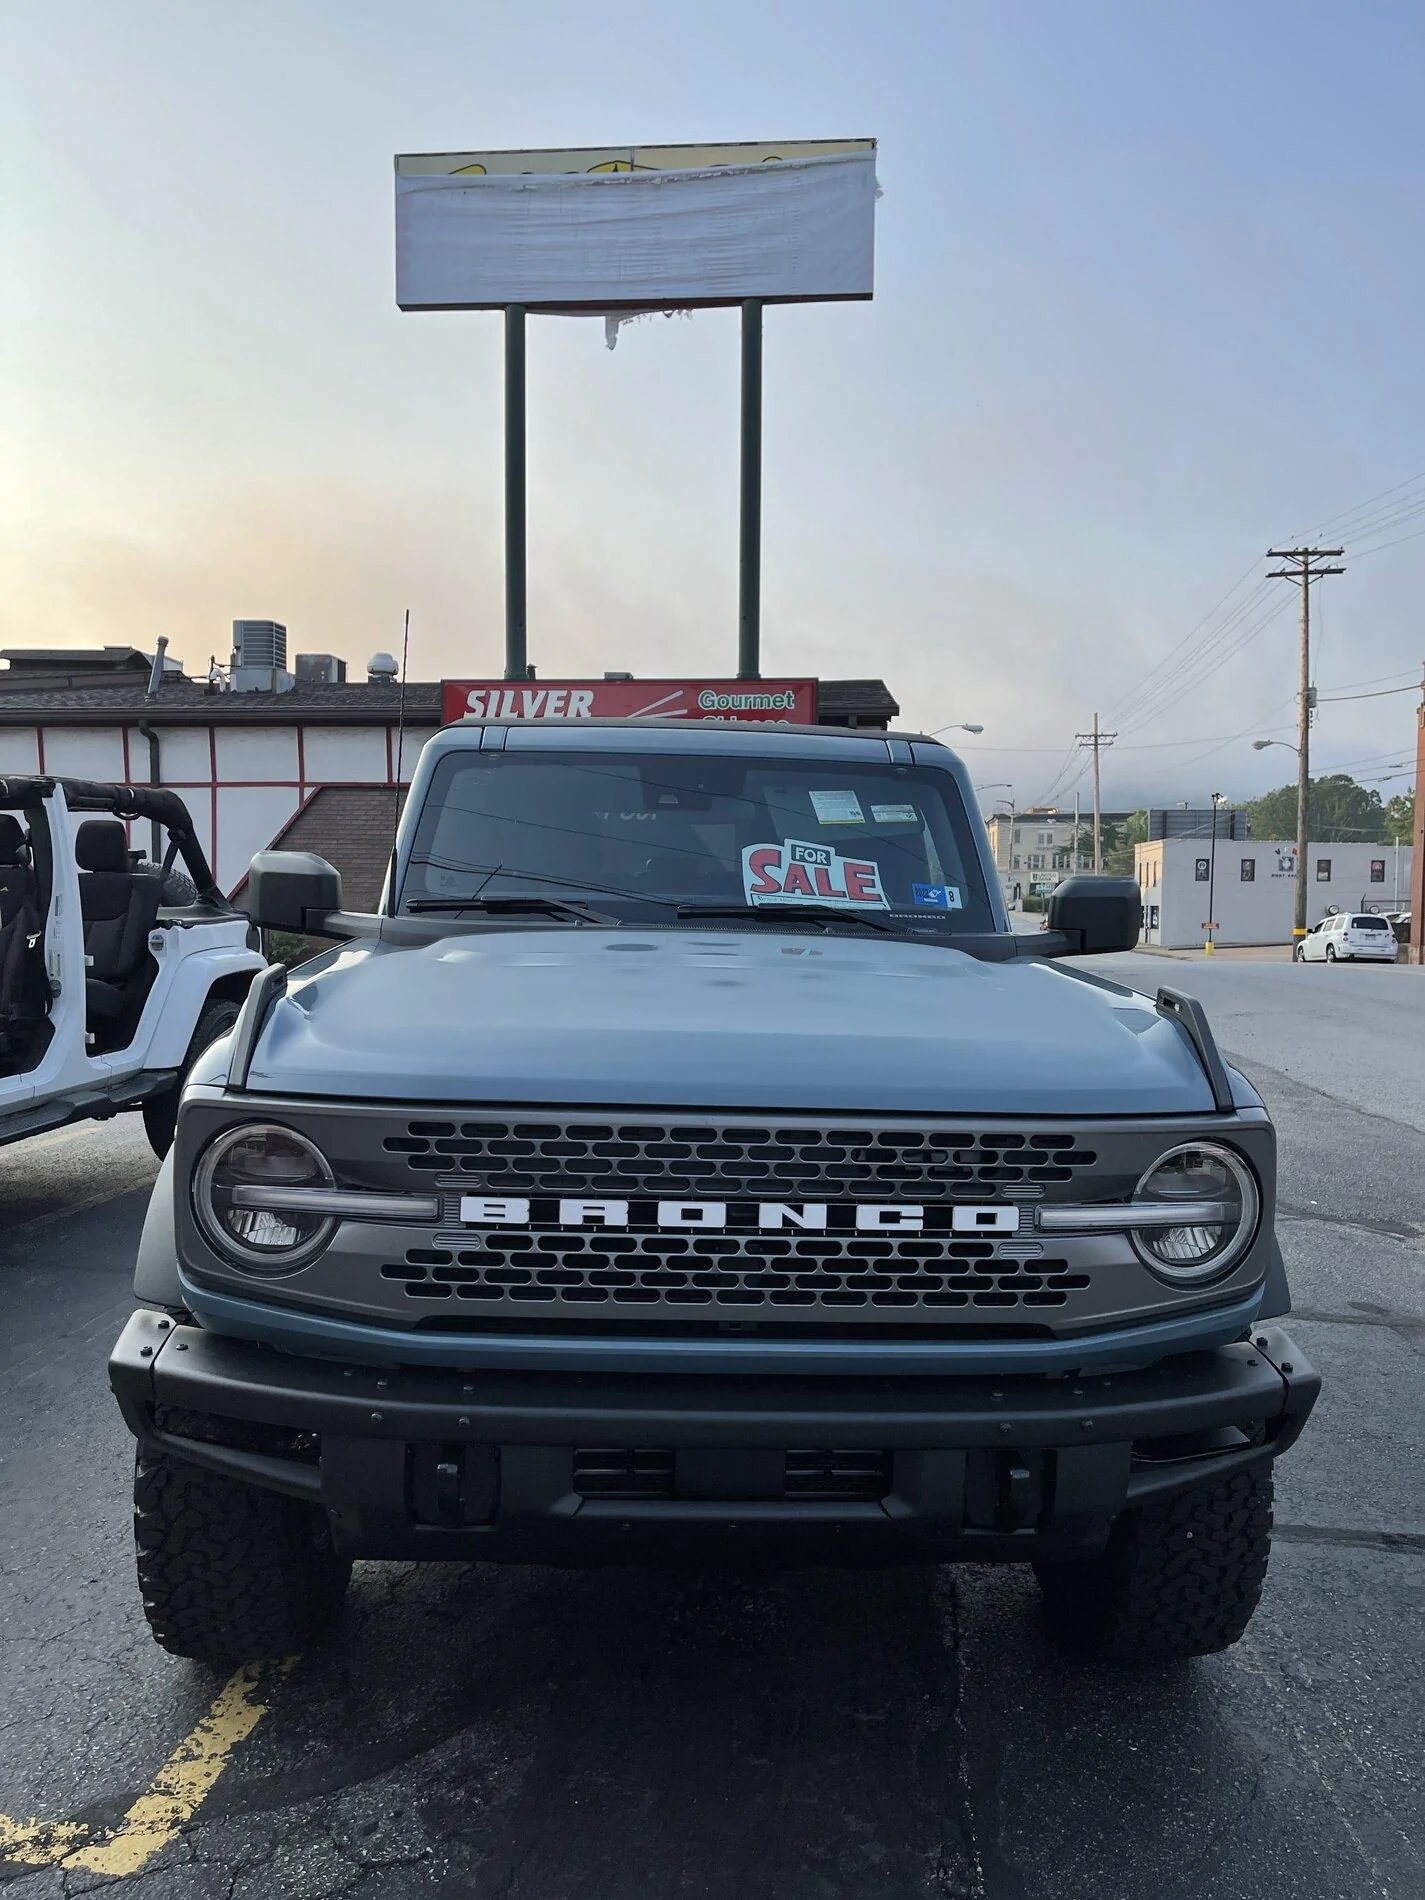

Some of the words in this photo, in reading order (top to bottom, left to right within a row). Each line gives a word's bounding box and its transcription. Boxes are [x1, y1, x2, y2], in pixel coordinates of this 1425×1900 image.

[463, 690, 595, 719] SILVER
[698, 690, 796, 710] Gourmet
[795, 846, 828, 864] FOR
[748, 848, 885, 902] SALE
[948, 890, 955, 902] 8
[460, 1196, 1019, 1232] BRONCO
